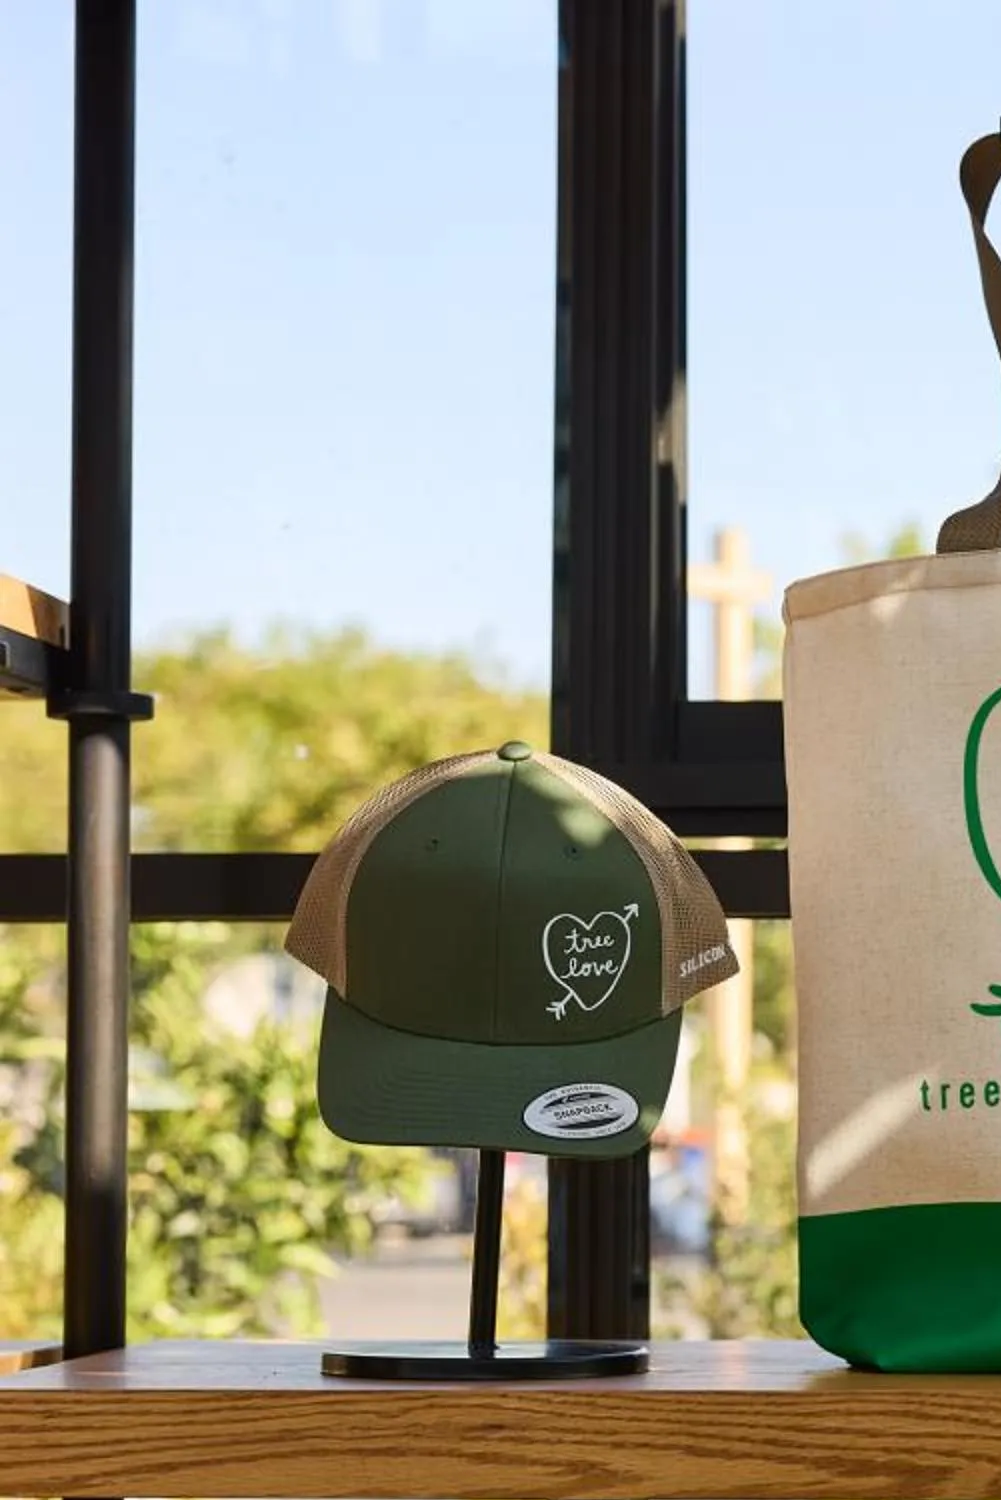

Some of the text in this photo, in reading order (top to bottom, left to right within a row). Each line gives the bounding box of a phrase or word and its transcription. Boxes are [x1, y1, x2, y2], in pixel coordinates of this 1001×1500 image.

[563, 927, 615, 954] tree
[560, 957, 619, 979] love
[680, 945, 727, 977] SILICON
